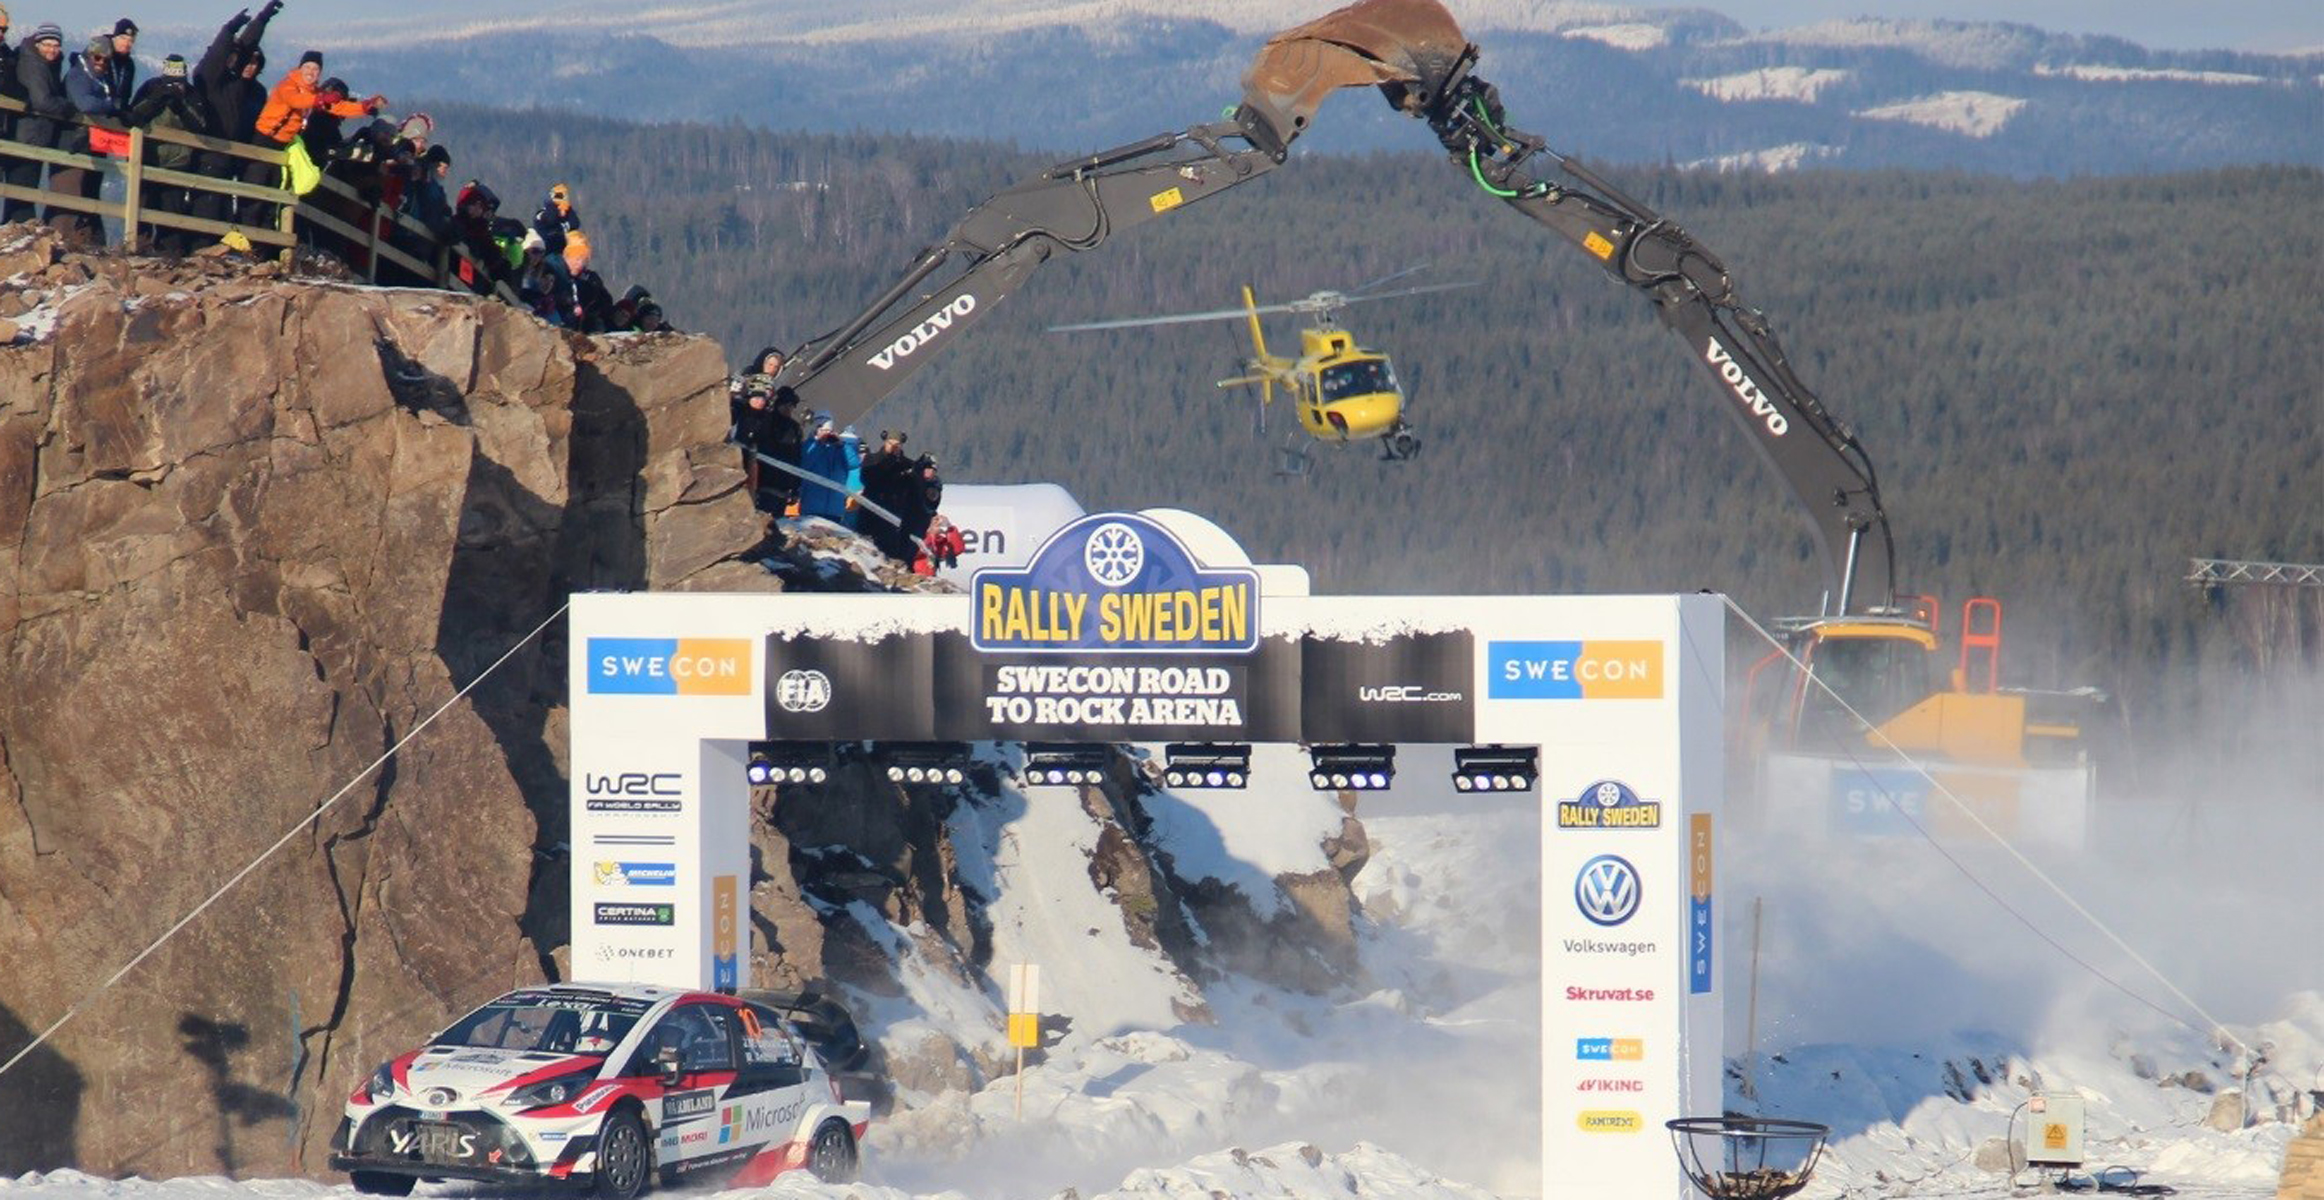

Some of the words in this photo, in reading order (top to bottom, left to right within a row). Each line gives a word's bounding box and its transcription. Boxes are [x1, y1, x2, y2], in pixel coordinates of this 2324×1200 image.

[866, 294, 976, 370] VOLVO
[1707, 336, 1788, 435] VOLVO
[982, 583, 1088, 641] RALLY
[1100, 583, 1247, 642] SWEDEN
[602, 656, 738, 677] SWECON
[1505, 660, 1649, 681] SWECON
[780, 678, 826, 703] FIA
[997, 666, 1135, 694] SWECON
[1138, 667, 1231, 694] ROAD
[986, 696, 1032, 723] TO
[1035, 697, 1126, 725] ROCK
[1128, 699, 1243, 726] ARENA
[586, 773, 682, 795] WRC
[1560, 803, 1599, 826] RALLY
[1602, 803, 1658, 827] SWEDEN
[597, 907, 656, 916] CERTINA
[1696, 831, 1708, 976] SWECON
[720, 893, 731, 984] ECON
[1563, 939, 1656, 957] Volkswagen
[618, 948, 675, 959] ONEBET
[1565, 986, 1655, 1001] Skruvat.se
[1584, 1079, 1644, 1092] VIKING
[390, 1129, 478, 1159] YARIS
